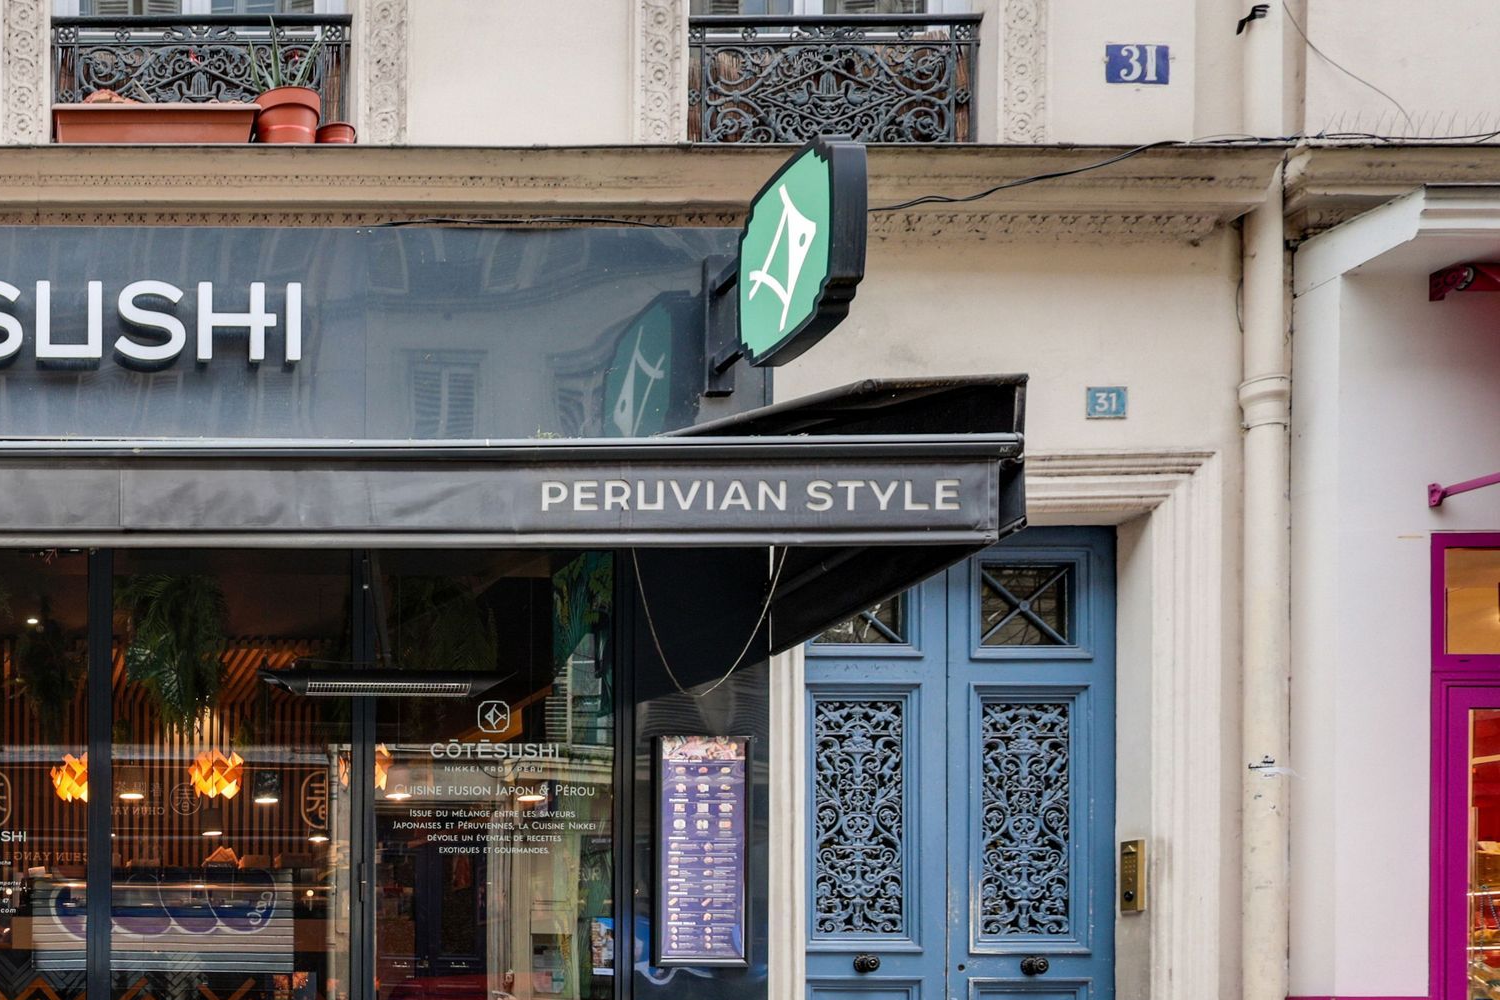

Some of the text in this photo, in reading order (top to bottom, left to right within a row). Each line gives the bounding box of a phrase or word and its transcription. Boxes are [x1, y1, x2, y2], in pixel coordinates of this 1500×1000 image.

[1120, 46, 1157, 81] 31
[1095, 392, 1117, 412] 31
[541, 480, 961, 511] PERUVIAN STYLE
[539, 784, 549, 796] &
